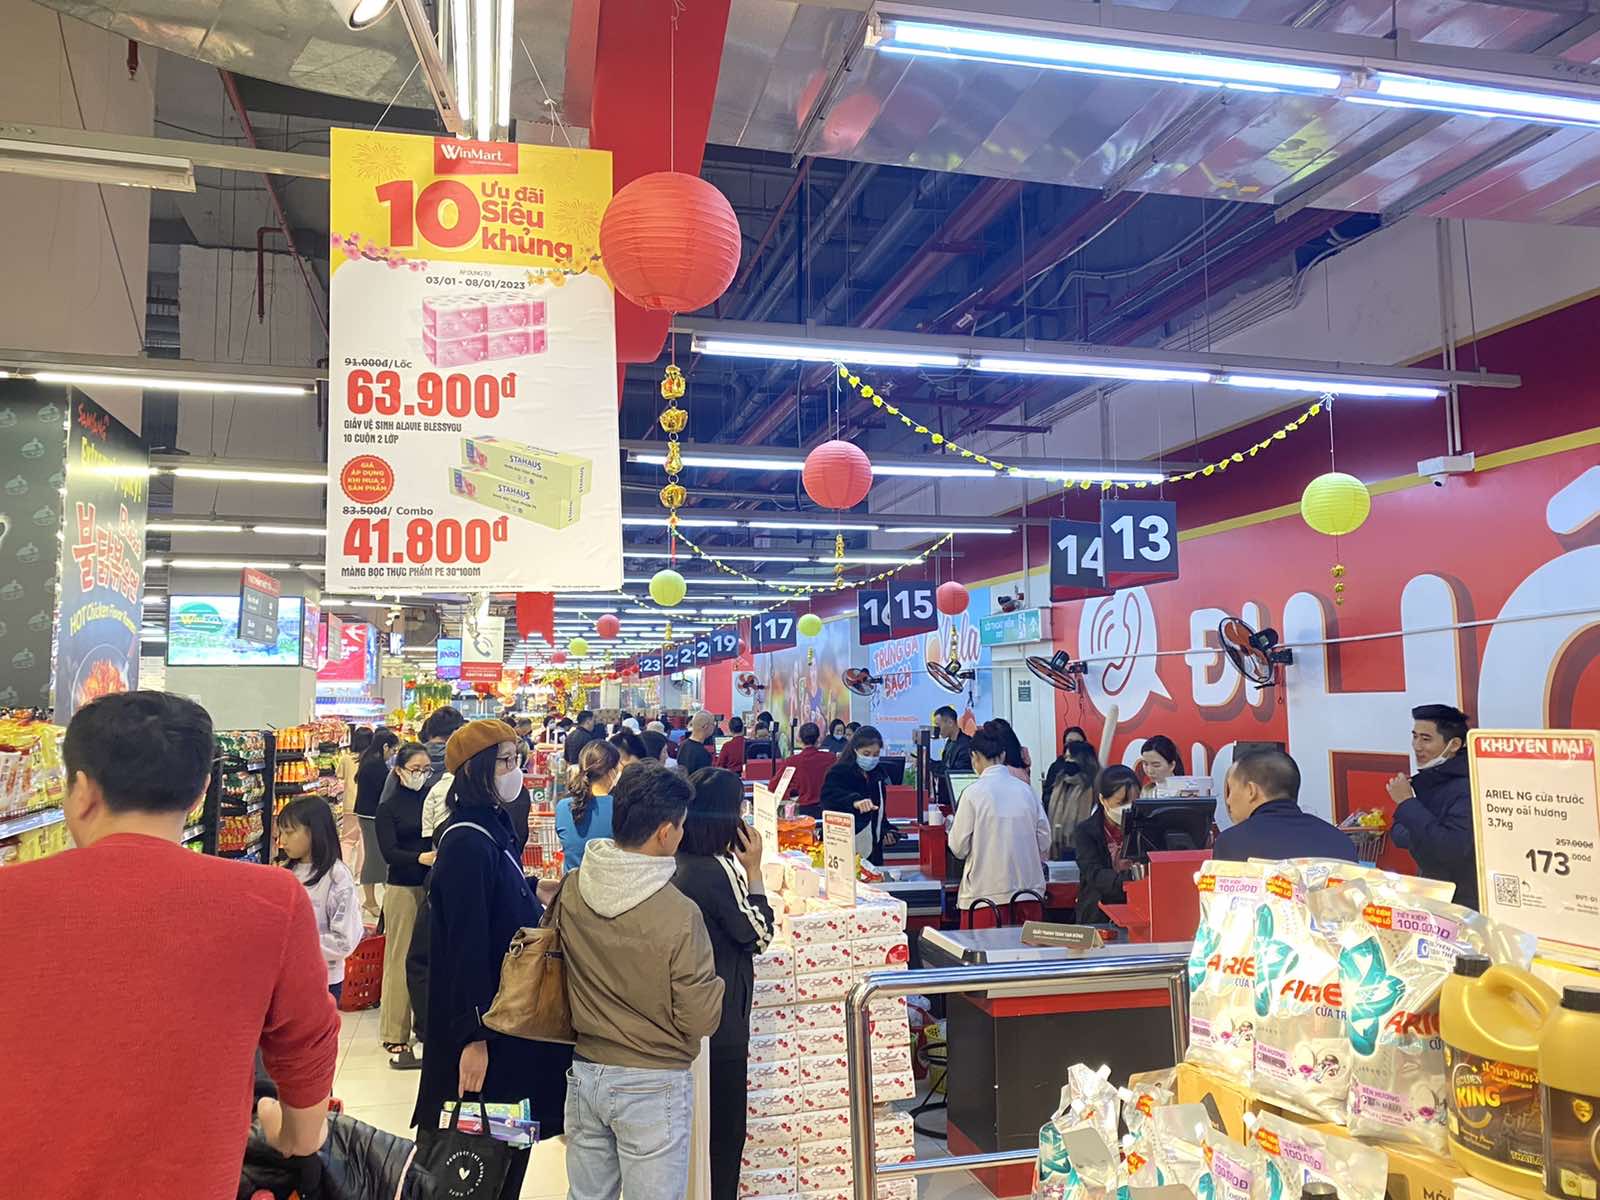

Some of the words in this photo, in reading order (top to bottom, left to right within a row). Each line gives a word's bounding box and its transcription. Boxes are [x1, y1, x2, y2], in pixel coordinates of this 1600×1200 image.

[440, 143, 503, 160] WinMart
[481, 180, 510, 199] Ưu
[515, 186, 544, 204] đãi
[375, 179, 480, 247] 10
[481, 200, 544, 228] Siêu
[481, 226, 573, 263] khủng
[425, 276, 456, 286] 03/01
[465, 278, 526, 290] 08/01/2023
[347, 369, 517, 419] 63.900đ
[375, 421, 394, 432] SINH
[424, 421, 462, 433] BLESSYOU
[343, 433, 353, 444] 10
[354, 432, 376, 445] CUỘN
[377, 434, 383, 444] 2
[384, 431, 400, 445] LỚP
[509, 455, 542, 471] STAHAUS
[498, 484, 531, 501] STAHAUS
[396, 505, 434, 517] Combo
[343, 515, 508, 564] 41.800đ
[1110, 515, 1171, 562] 13
[368, 566, 385, 579] BỌC
[386, 566, 407, 579] THỰC
[434, 566, 445, 577] PE
[894, 590, 934, 621] 15
[762, 618, 794, 640] 17
[712, 634, 737, 652] 19
[643, 659, 661, 672] 23
[1485, 789, 1514, 800] ARIEL
[1516, 791, 1533, 801] NG
[1534, 807, 1568, 821] hương
[827, 855, 839, 870] 26
[1525, 848, 1571, 876] 173
[1456, 1085, 1502, 1109] KING
